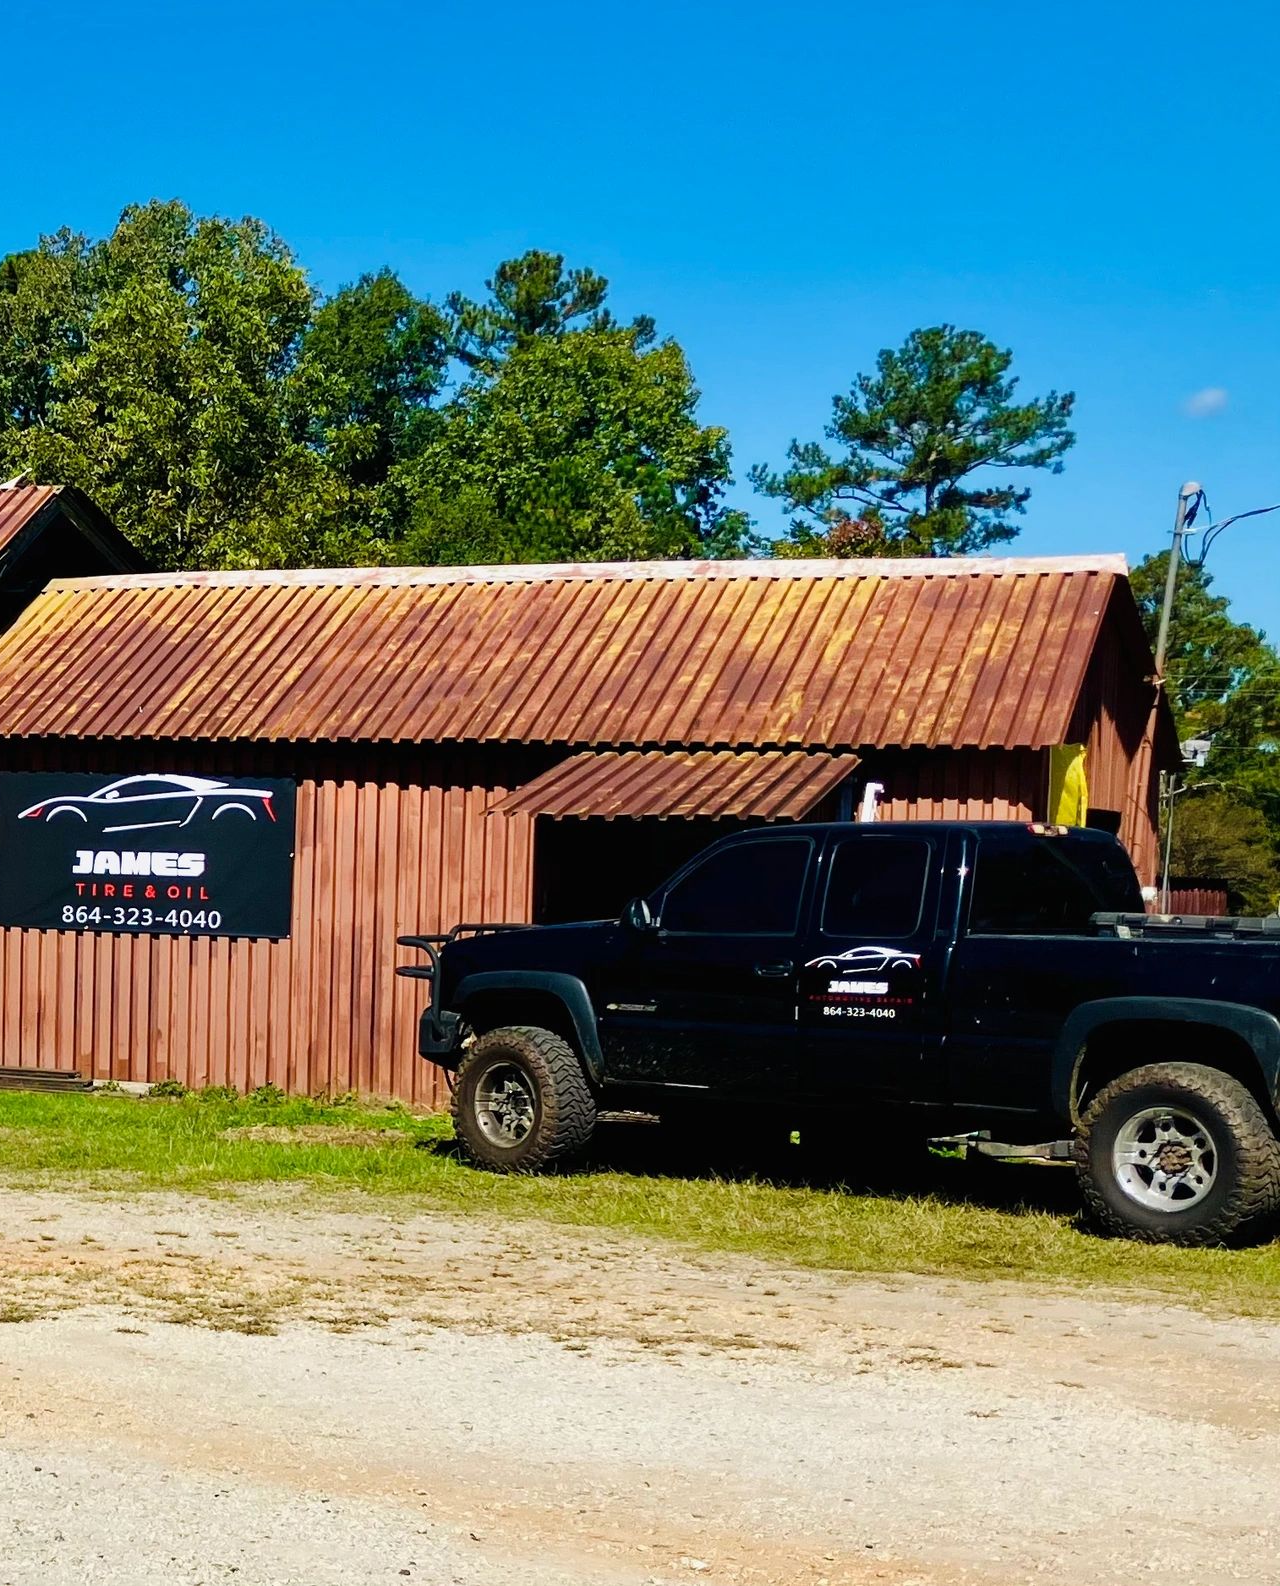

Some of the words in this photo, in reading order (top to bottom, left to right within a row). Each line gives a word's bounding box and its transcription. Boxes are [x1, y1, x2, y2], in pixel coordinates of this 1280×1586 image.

[72, 850, 206, 878] JAMES
[75, 883, 135, 898] TIRE
[144, 884, 157, 900] &
[167, 885, 209, 900] OIL
[61, 905, 222, 929] 864-323-4040
[827, 980, 889, 995] JAMES
[822, 1006, 896, 1018] 864-323-4040
